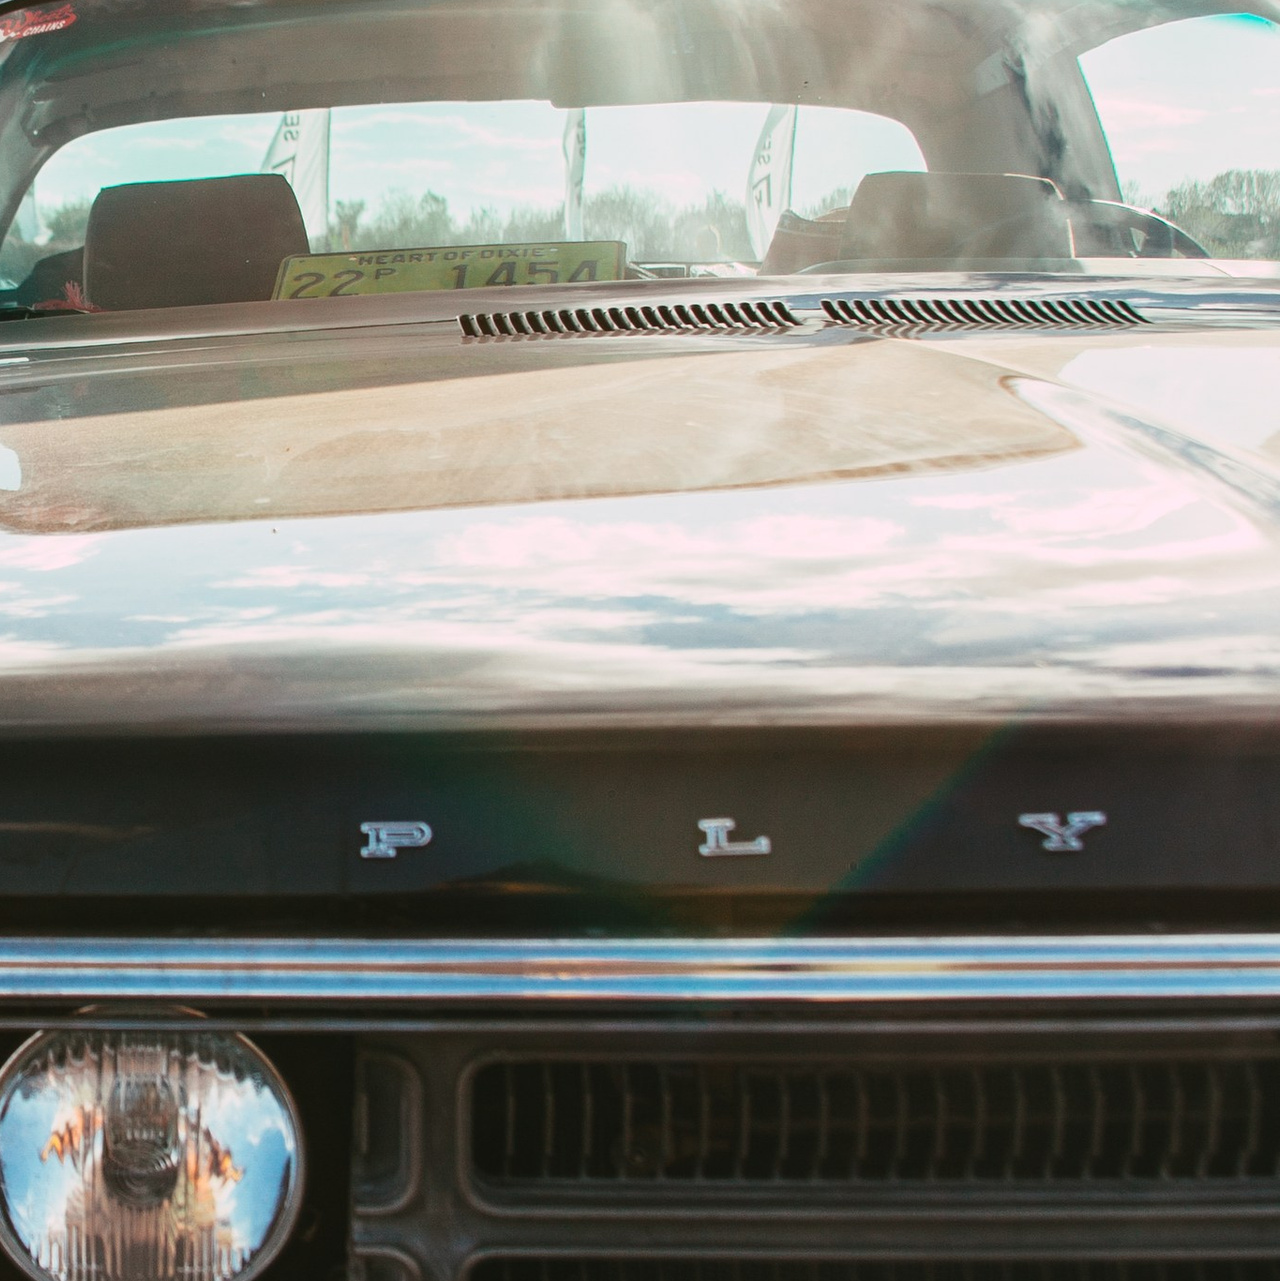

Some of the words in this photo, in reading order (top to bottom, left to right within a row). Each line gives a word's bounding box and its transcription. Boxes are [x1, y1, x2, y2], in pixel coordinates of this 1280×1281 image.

[22, 19, 66, 37] CHAINS
[357, 251, 438, 266] HEART
[443, 249, 475, 261] OF
[479, 247, 547, 260] DIXIE
[451, 259, 600, 290] 1454
